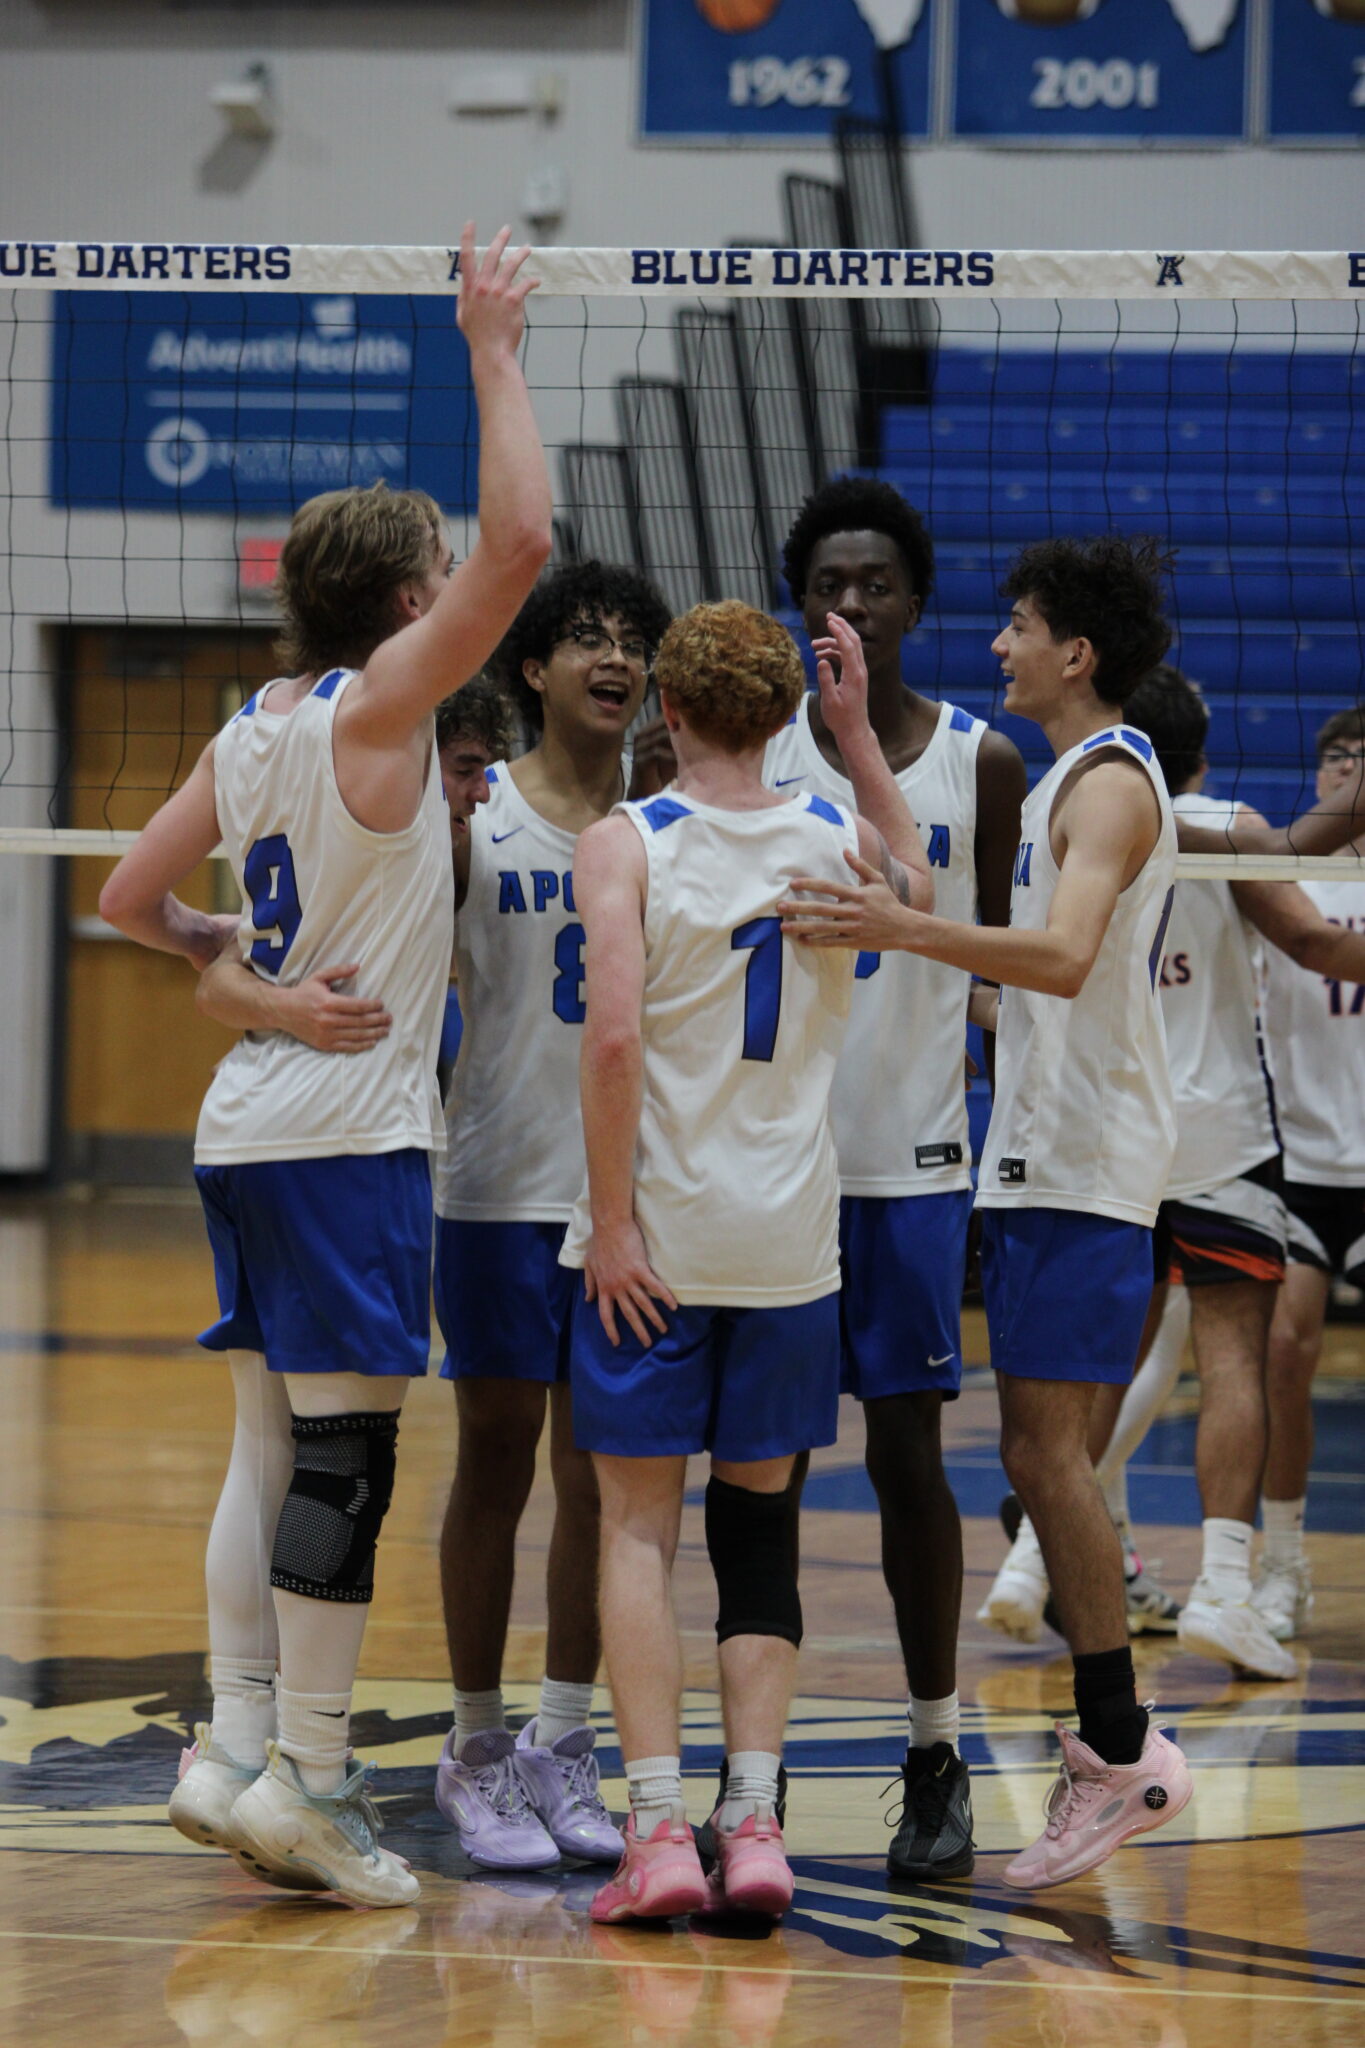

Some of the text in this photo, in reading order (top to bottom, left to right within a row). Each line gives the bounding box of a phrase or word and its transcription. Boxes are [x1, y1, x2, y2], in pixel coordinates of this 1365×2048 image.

[729, 56, 851, 107] 1962
[1031, 57, 1159, 109] 2001
[77, 245, 291, 280] DARTERS
[632, 250, 994, 287] BLUE DARTERS
[244, 833, 302, 976] 9
[731, 916, 783, 1062] 1
[1012, 1166, 1020, 1175] M
